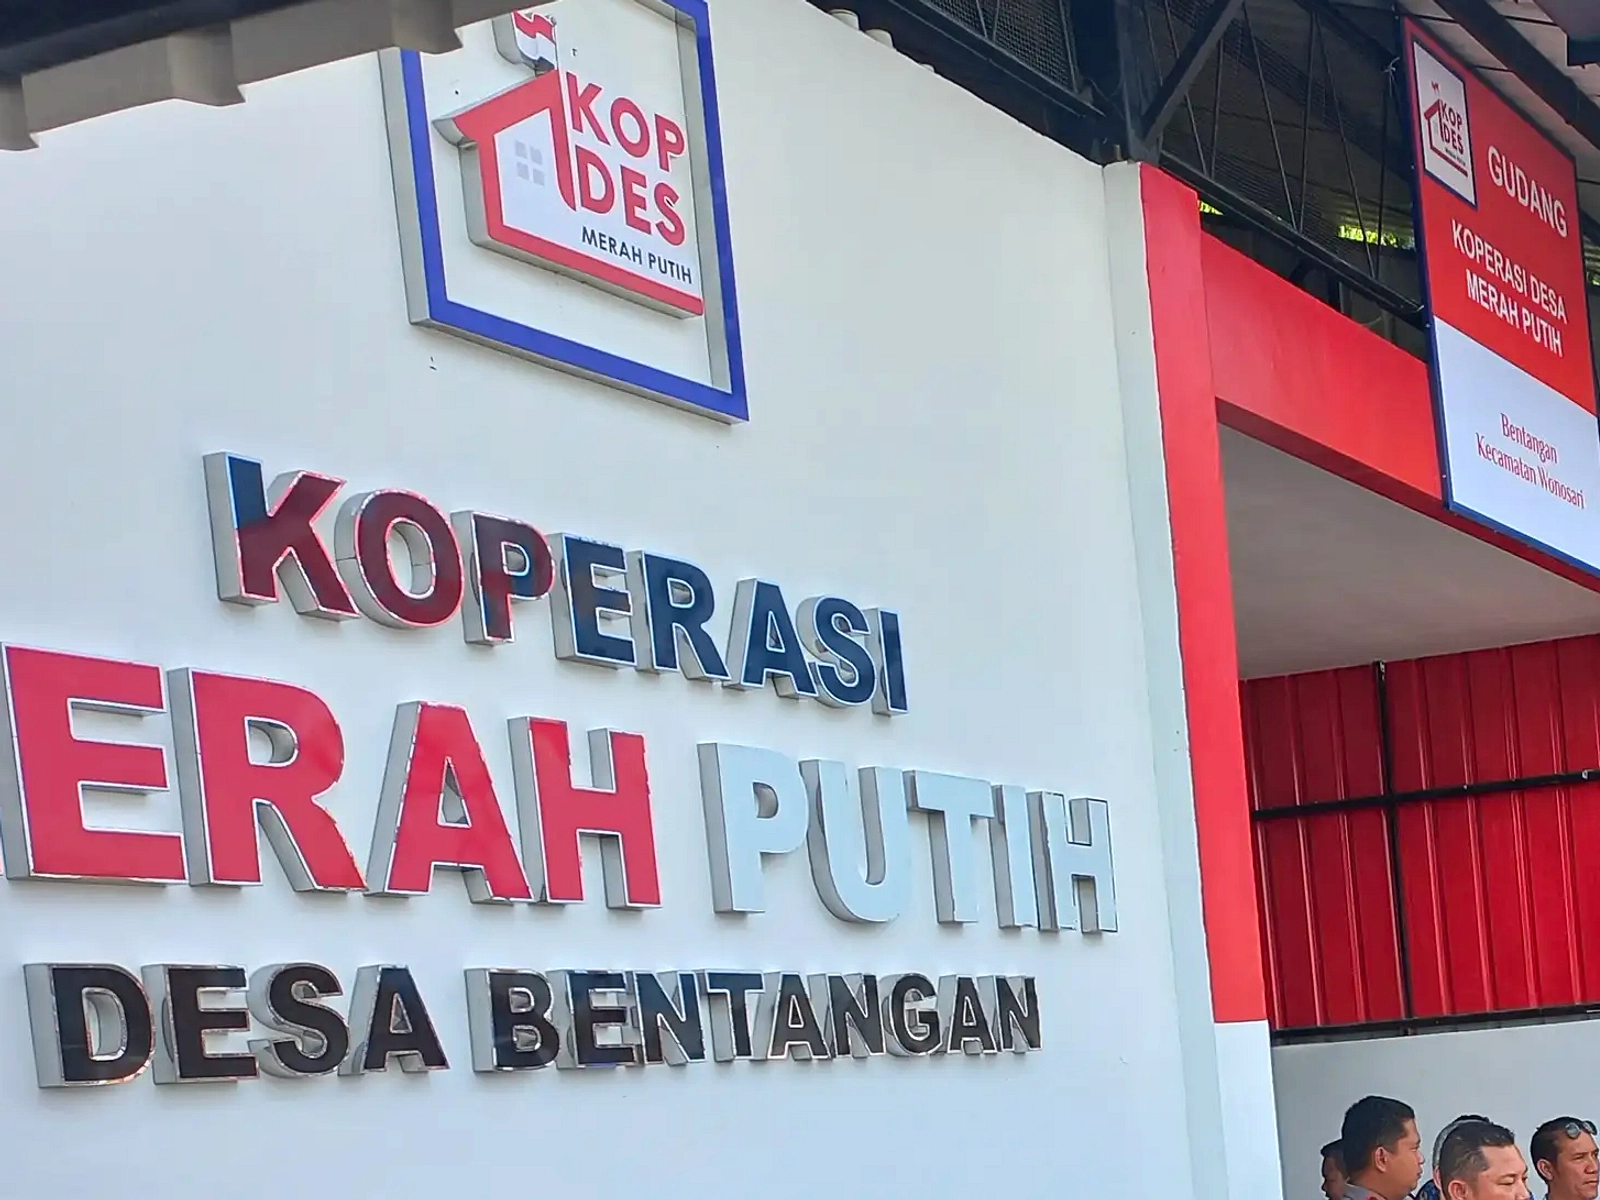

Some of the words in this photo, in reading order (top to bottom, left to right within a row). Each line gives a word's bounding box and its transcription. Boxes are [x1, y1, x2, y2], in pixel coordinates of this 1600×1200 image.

[567, 71, 684, 172] KOP
[575, 145, 685, 246] DES
[1488, 146, 1568, 237] GUDANG
[582, 226, 642, 266] MERAH
[649, 255, 692, 284] PUTIH
[1452, 218, 1527, 297] KOPERASI
[1530, 275, 1567, 325] DESA
[1466, 268, 1520, 329] MERAH
[1522, 307, 1563, 358] PUTIH
[1475, 433, 1537, 485] Kecamatan
[1538, 465, 1585, 510] Wonosari
[1500, 412, 1558, 464] Bentangan
[206, 452, 909, 715] KOPERASI
[0, 642, 662, 910] ERAH
[698, 741, 1119, 934] PUTIH
[24, 963, 449, 1089] DESA
[464, 967, 1043, 1073] BENTANGAN
